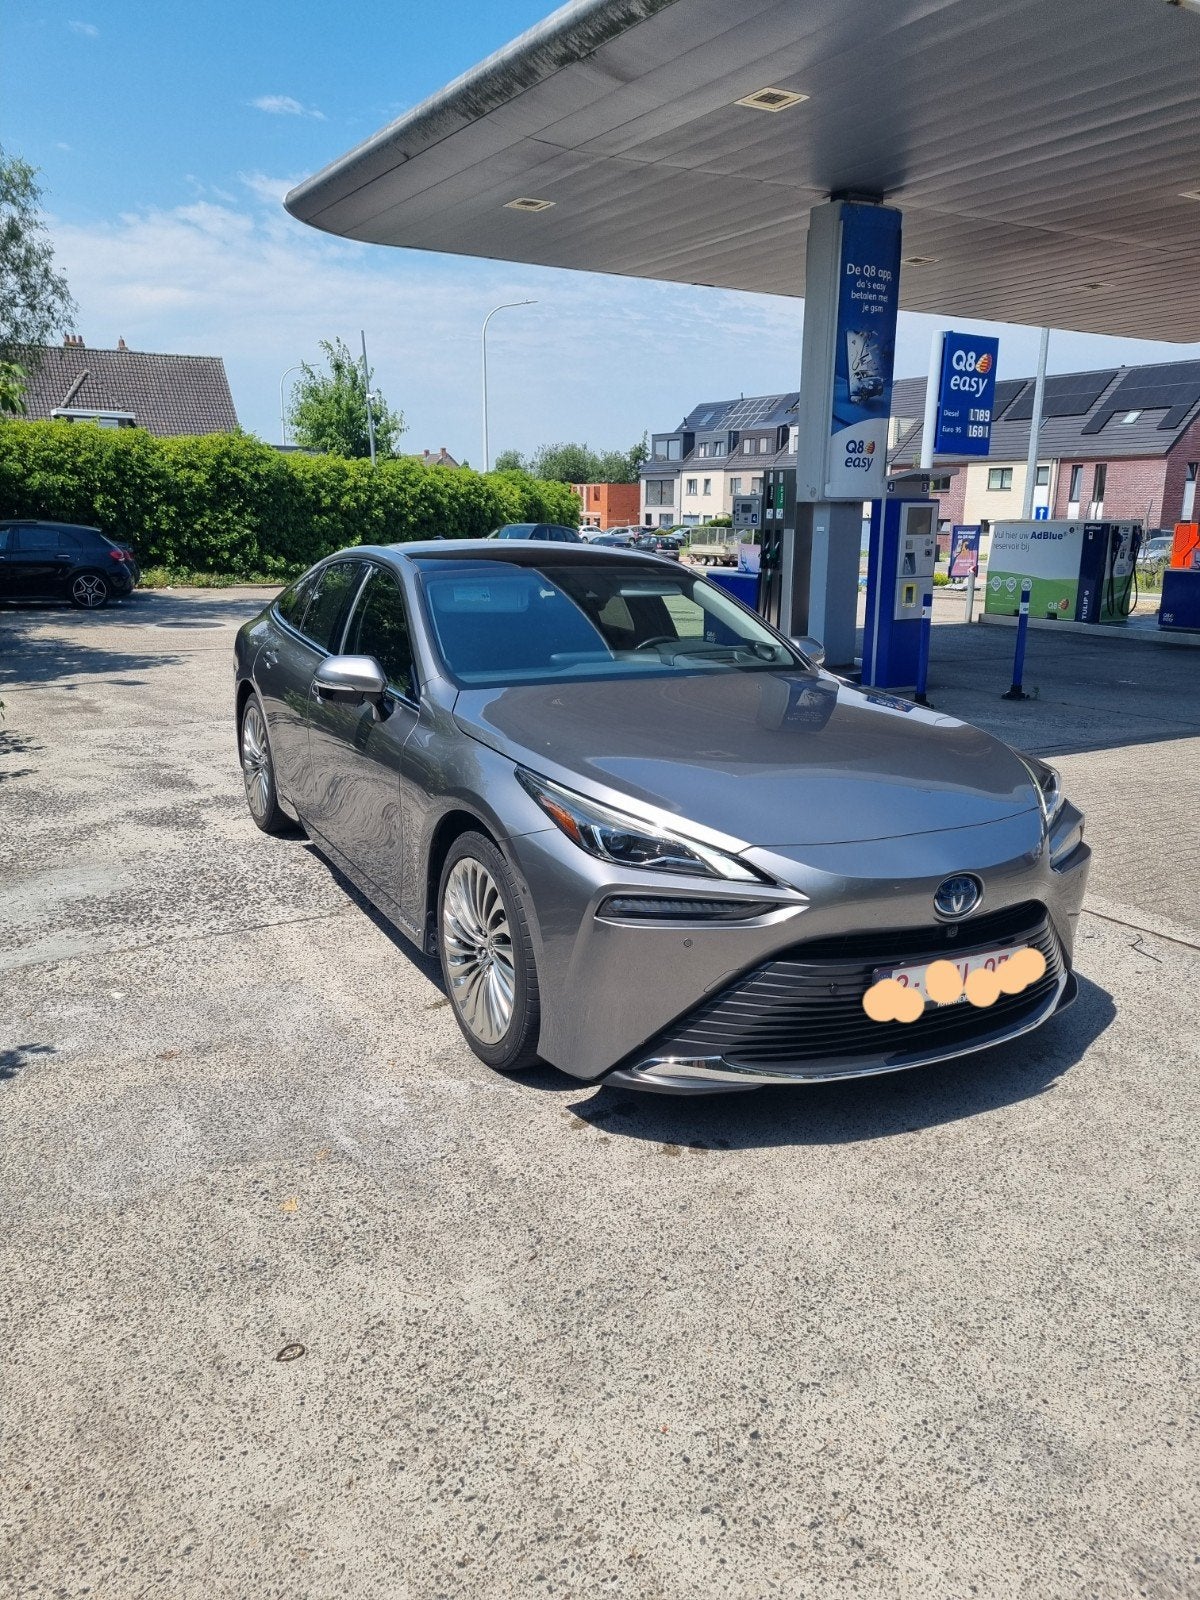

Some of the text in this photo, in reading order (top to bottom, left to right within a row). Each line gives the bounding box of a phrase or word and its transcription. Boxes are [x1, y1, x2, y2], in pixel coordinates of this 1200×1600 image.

[846, 263, 861, 275] De
[863, 264, 876, 278] Q8
[856, 279, 887, 293] da's easy
[851, 290, 877, 301] betalen
[861, 302, 884, 314] je gsm
[952, 349, 976, 372] Q8
[950, 374, 988, 398] easy
[943, 409, 959, 418] Diesel
[942, 425, 954, 433] Euro
[845, 439, 864, 454] Q8
[844, 456, 874, 472] easy
[1005, 531, 1018, 539] hier
[1020, 541, 1030, 552] bij
[1047, 601, 1058, 610] Q8
[1081, 597, 1089, 620] TULIP
